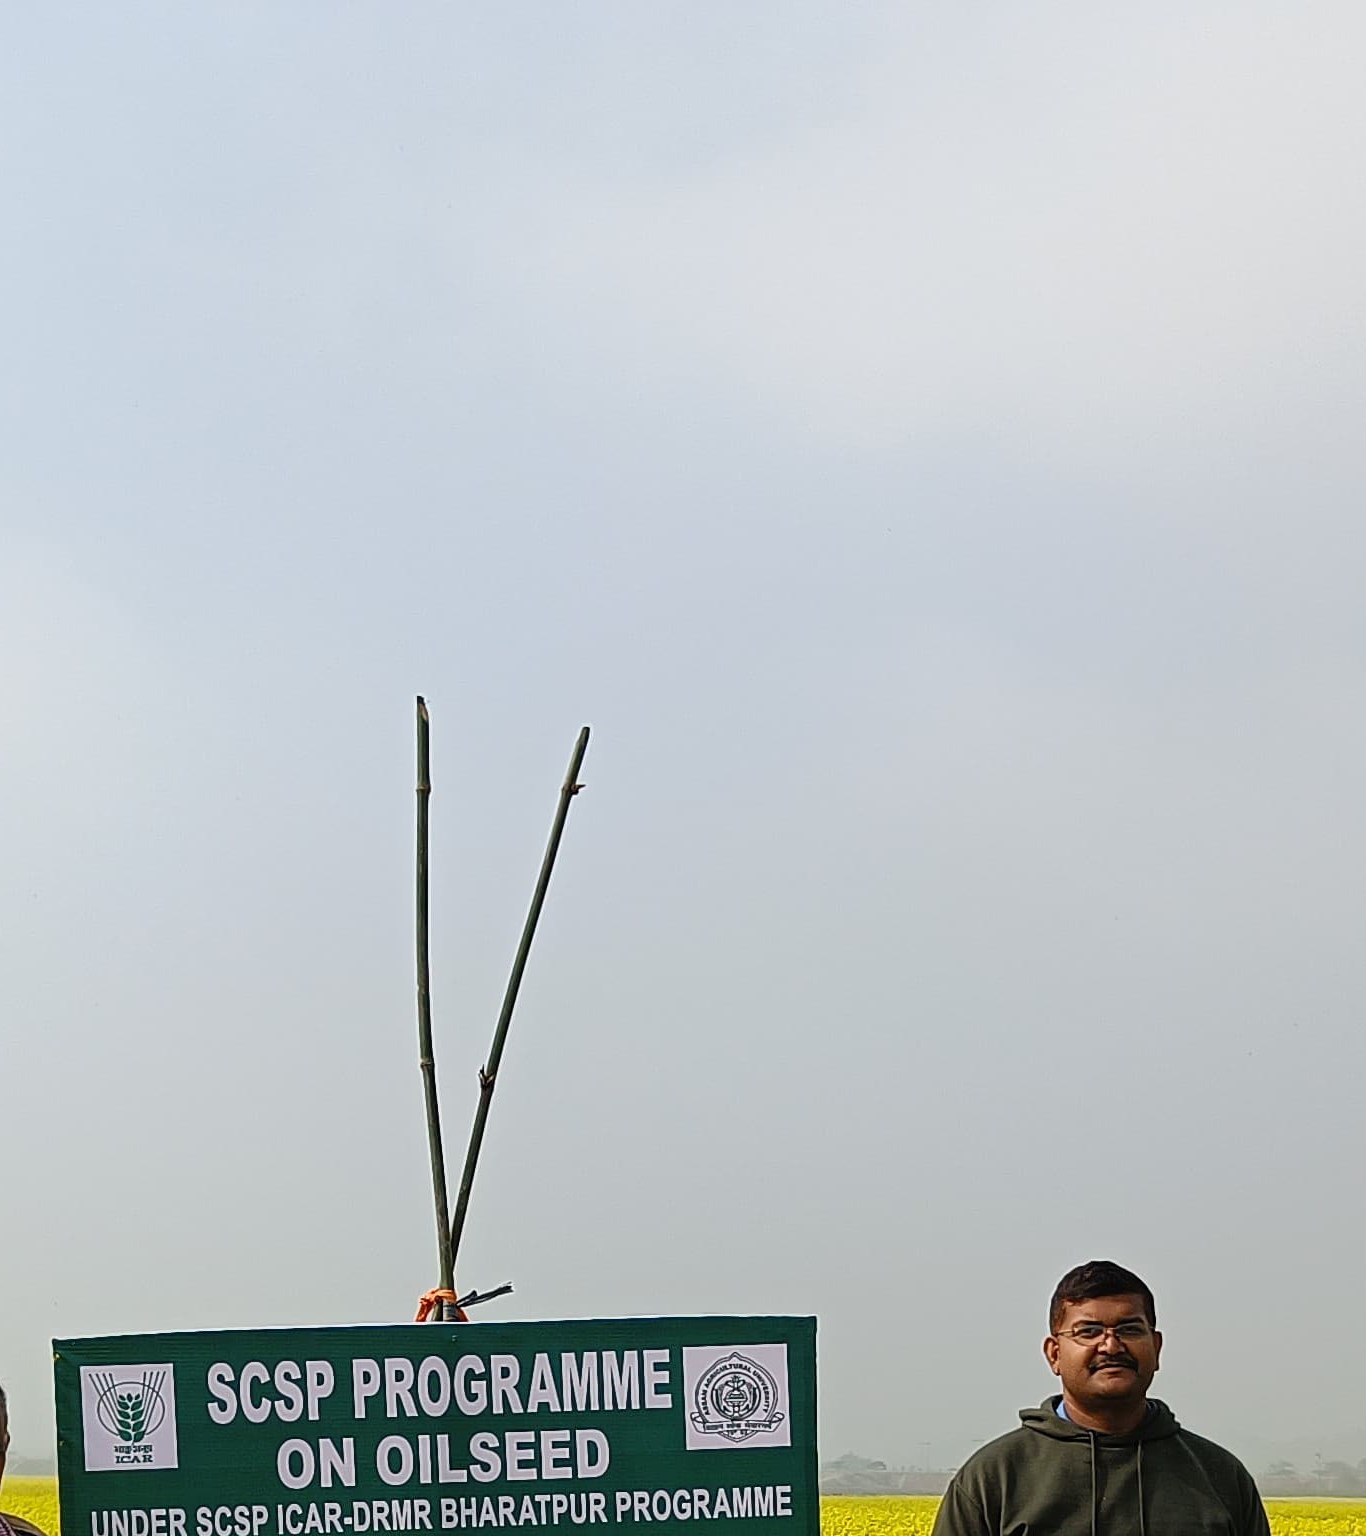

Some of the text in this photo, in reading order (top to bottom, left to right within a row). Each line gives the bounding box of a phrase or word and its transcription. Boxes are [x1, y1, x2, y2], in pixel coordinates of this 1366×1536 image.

[207, 1348, 673, 1425] SCSP PROGRAMME
[115, 1454, 154, 1464] ICAR
[277, 1428, 610, 1490] ON OILSEED
[277, 1499, 433, 1535] ICAR-DRMR
[440, 1492, 608, 1529] BHARATPUR
[615, 1485, 793, 1523] PROGRAMME
